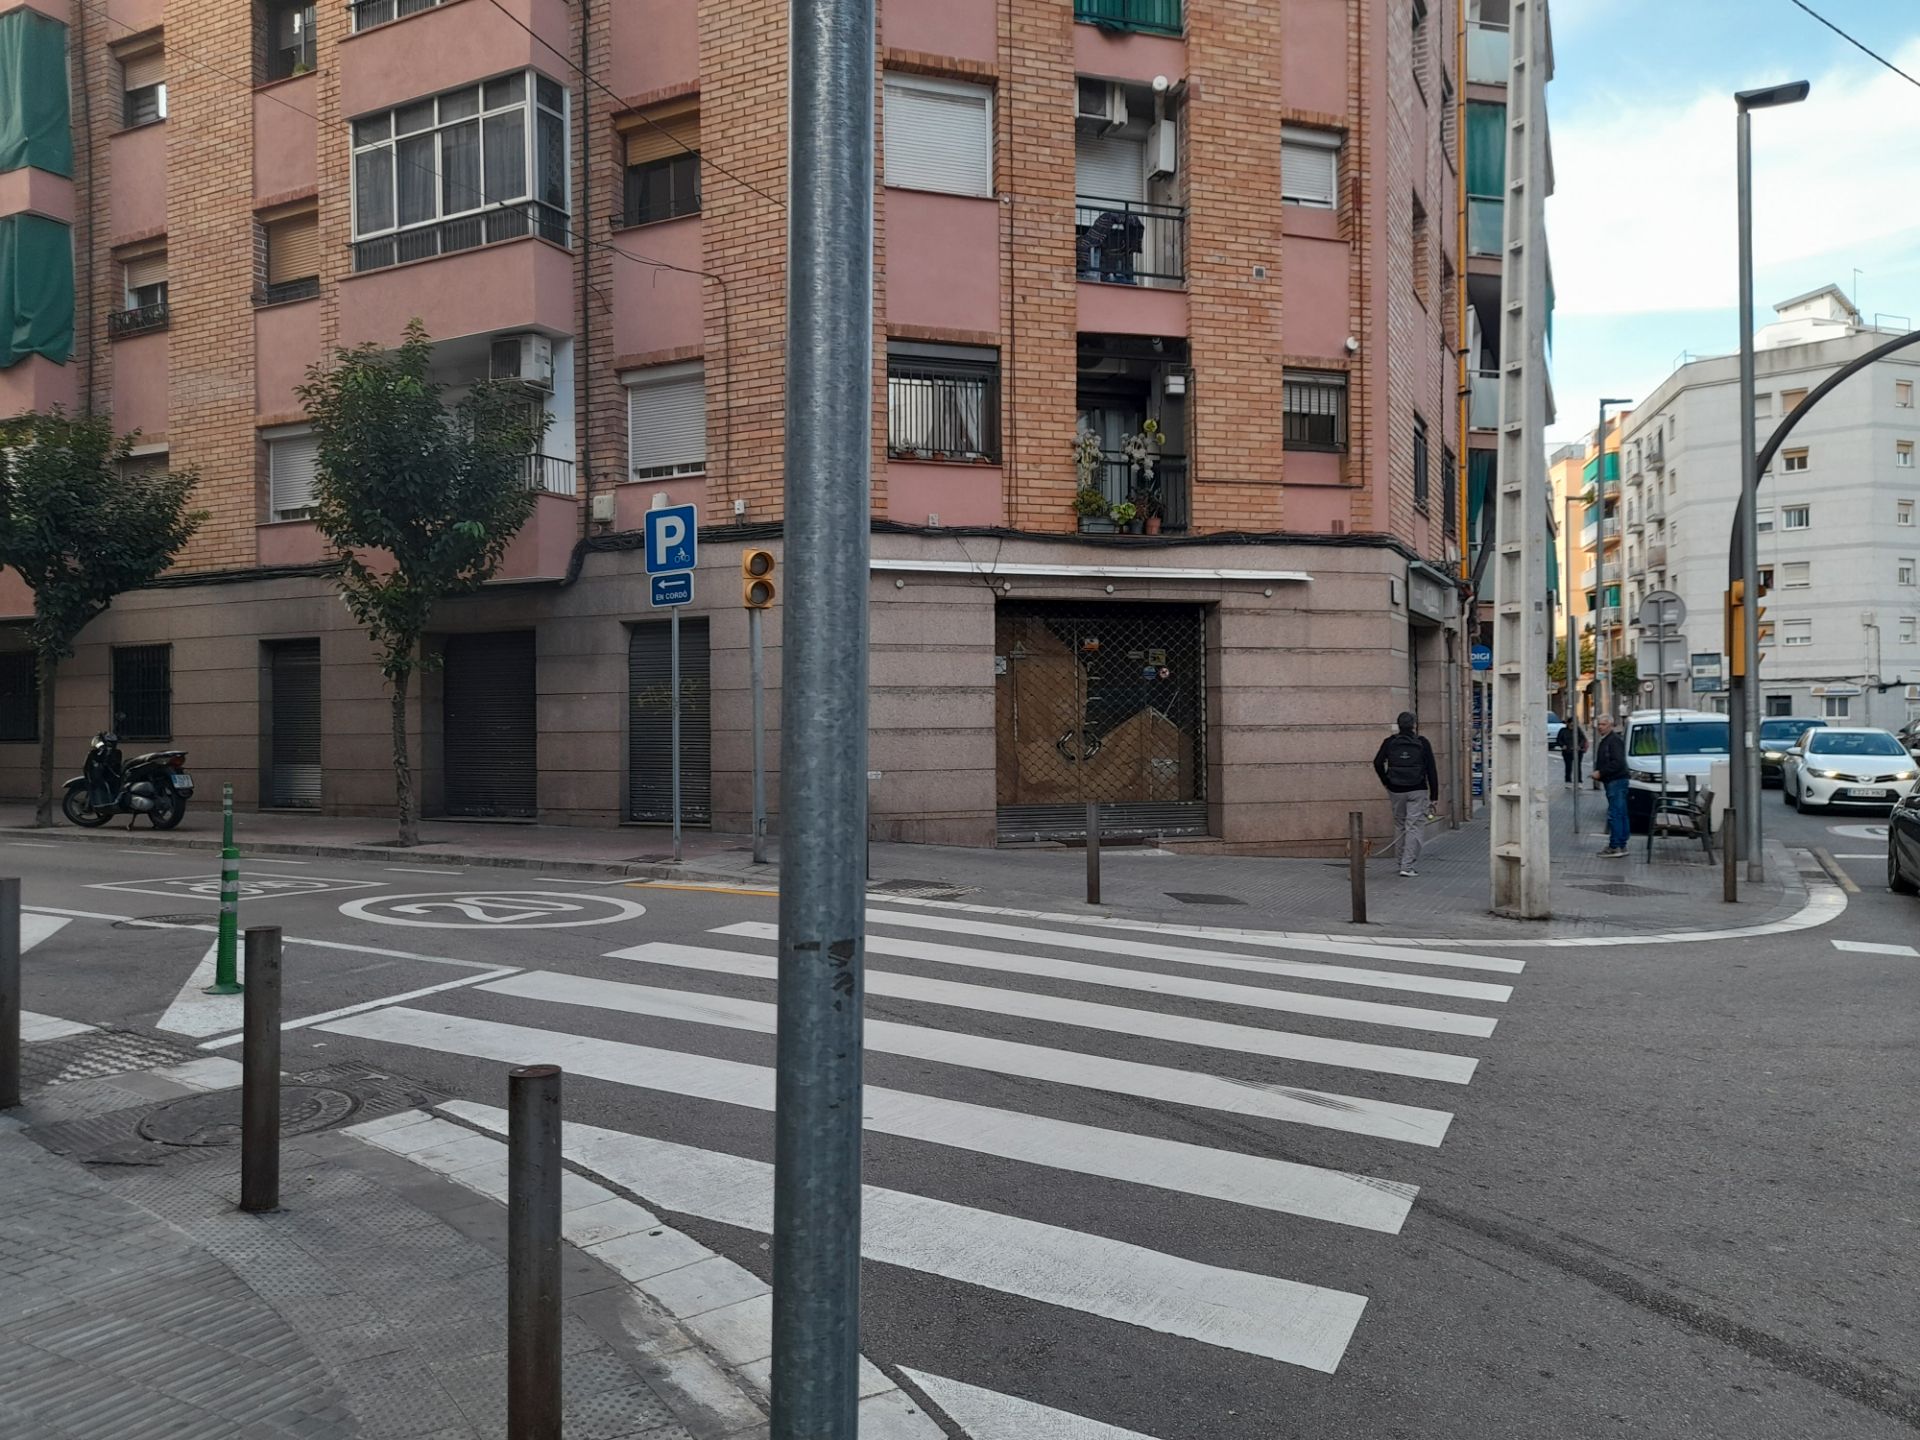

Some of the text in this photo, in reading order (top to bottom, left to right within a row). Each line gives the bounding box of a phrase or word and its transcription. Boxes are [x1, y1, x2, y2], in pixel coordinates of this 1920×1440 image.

[656, 515, 686, 565] P
[656, 593, 664, 601] EN
[1471, 652, 1490, 661] DIGI
[390, 896, 584, 922] 20
